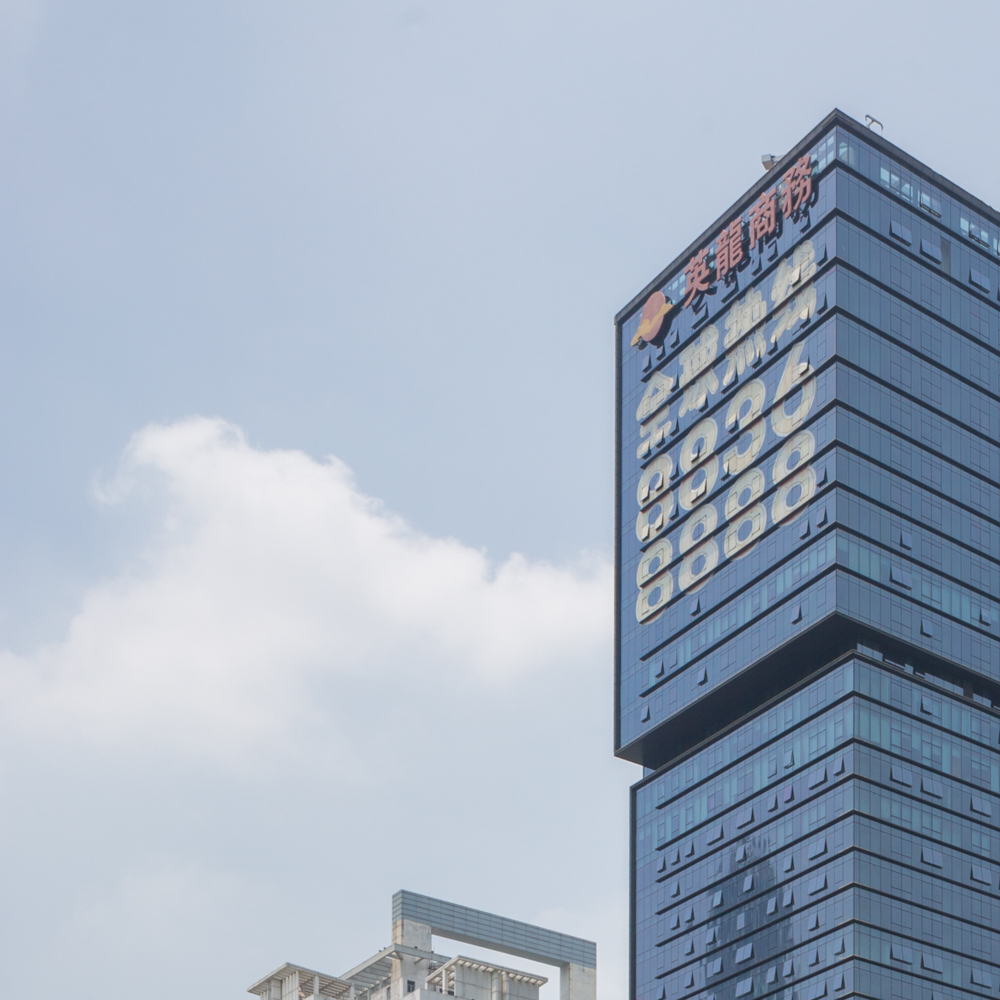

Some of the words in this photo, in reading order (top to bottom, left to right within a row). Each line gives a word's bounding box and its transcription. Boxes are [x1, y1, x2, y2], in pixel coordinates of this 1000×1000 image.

[684, 154, 813, 309] 英龍商務
[636, 341, 817, 542] 8836
[636, 429, 817, 625] 8888
